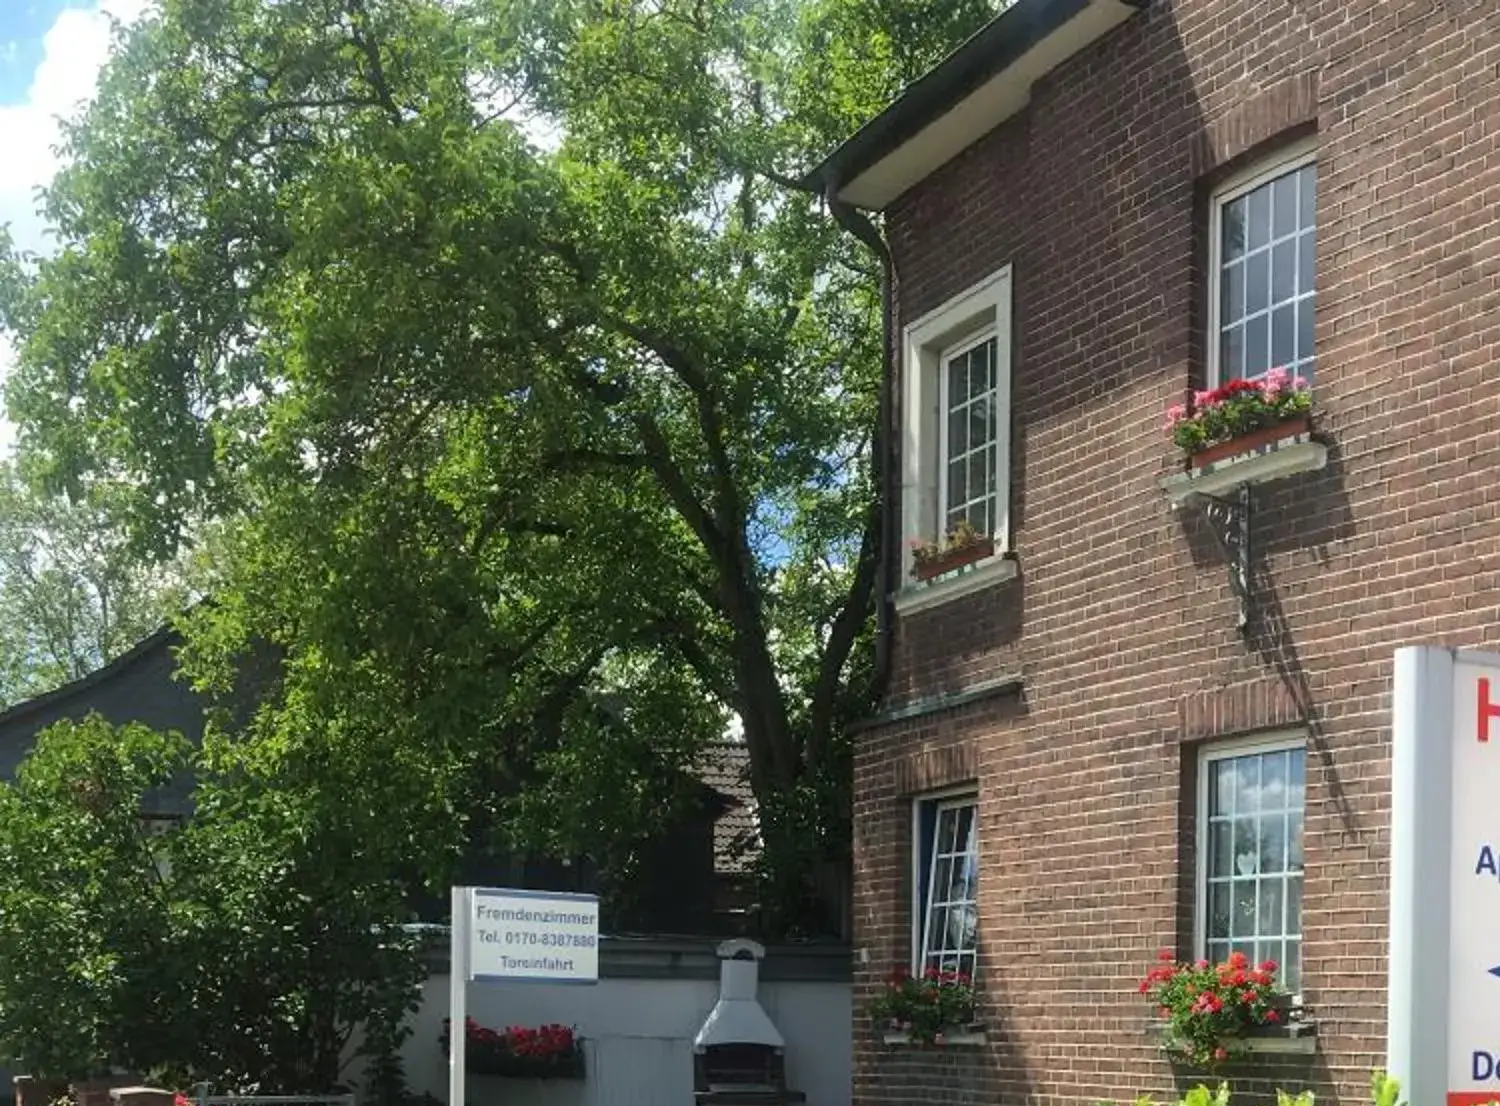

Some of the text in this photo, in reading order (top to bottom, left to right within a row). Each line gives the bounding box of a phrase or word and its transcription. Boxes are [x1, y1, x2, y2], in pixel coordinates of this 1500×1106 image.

[477, 905, 595, 925] Fremdenzimmer
[479, 930, 499, 943] Tel.
[500, 954, 575, 971] Toreinfahrt
